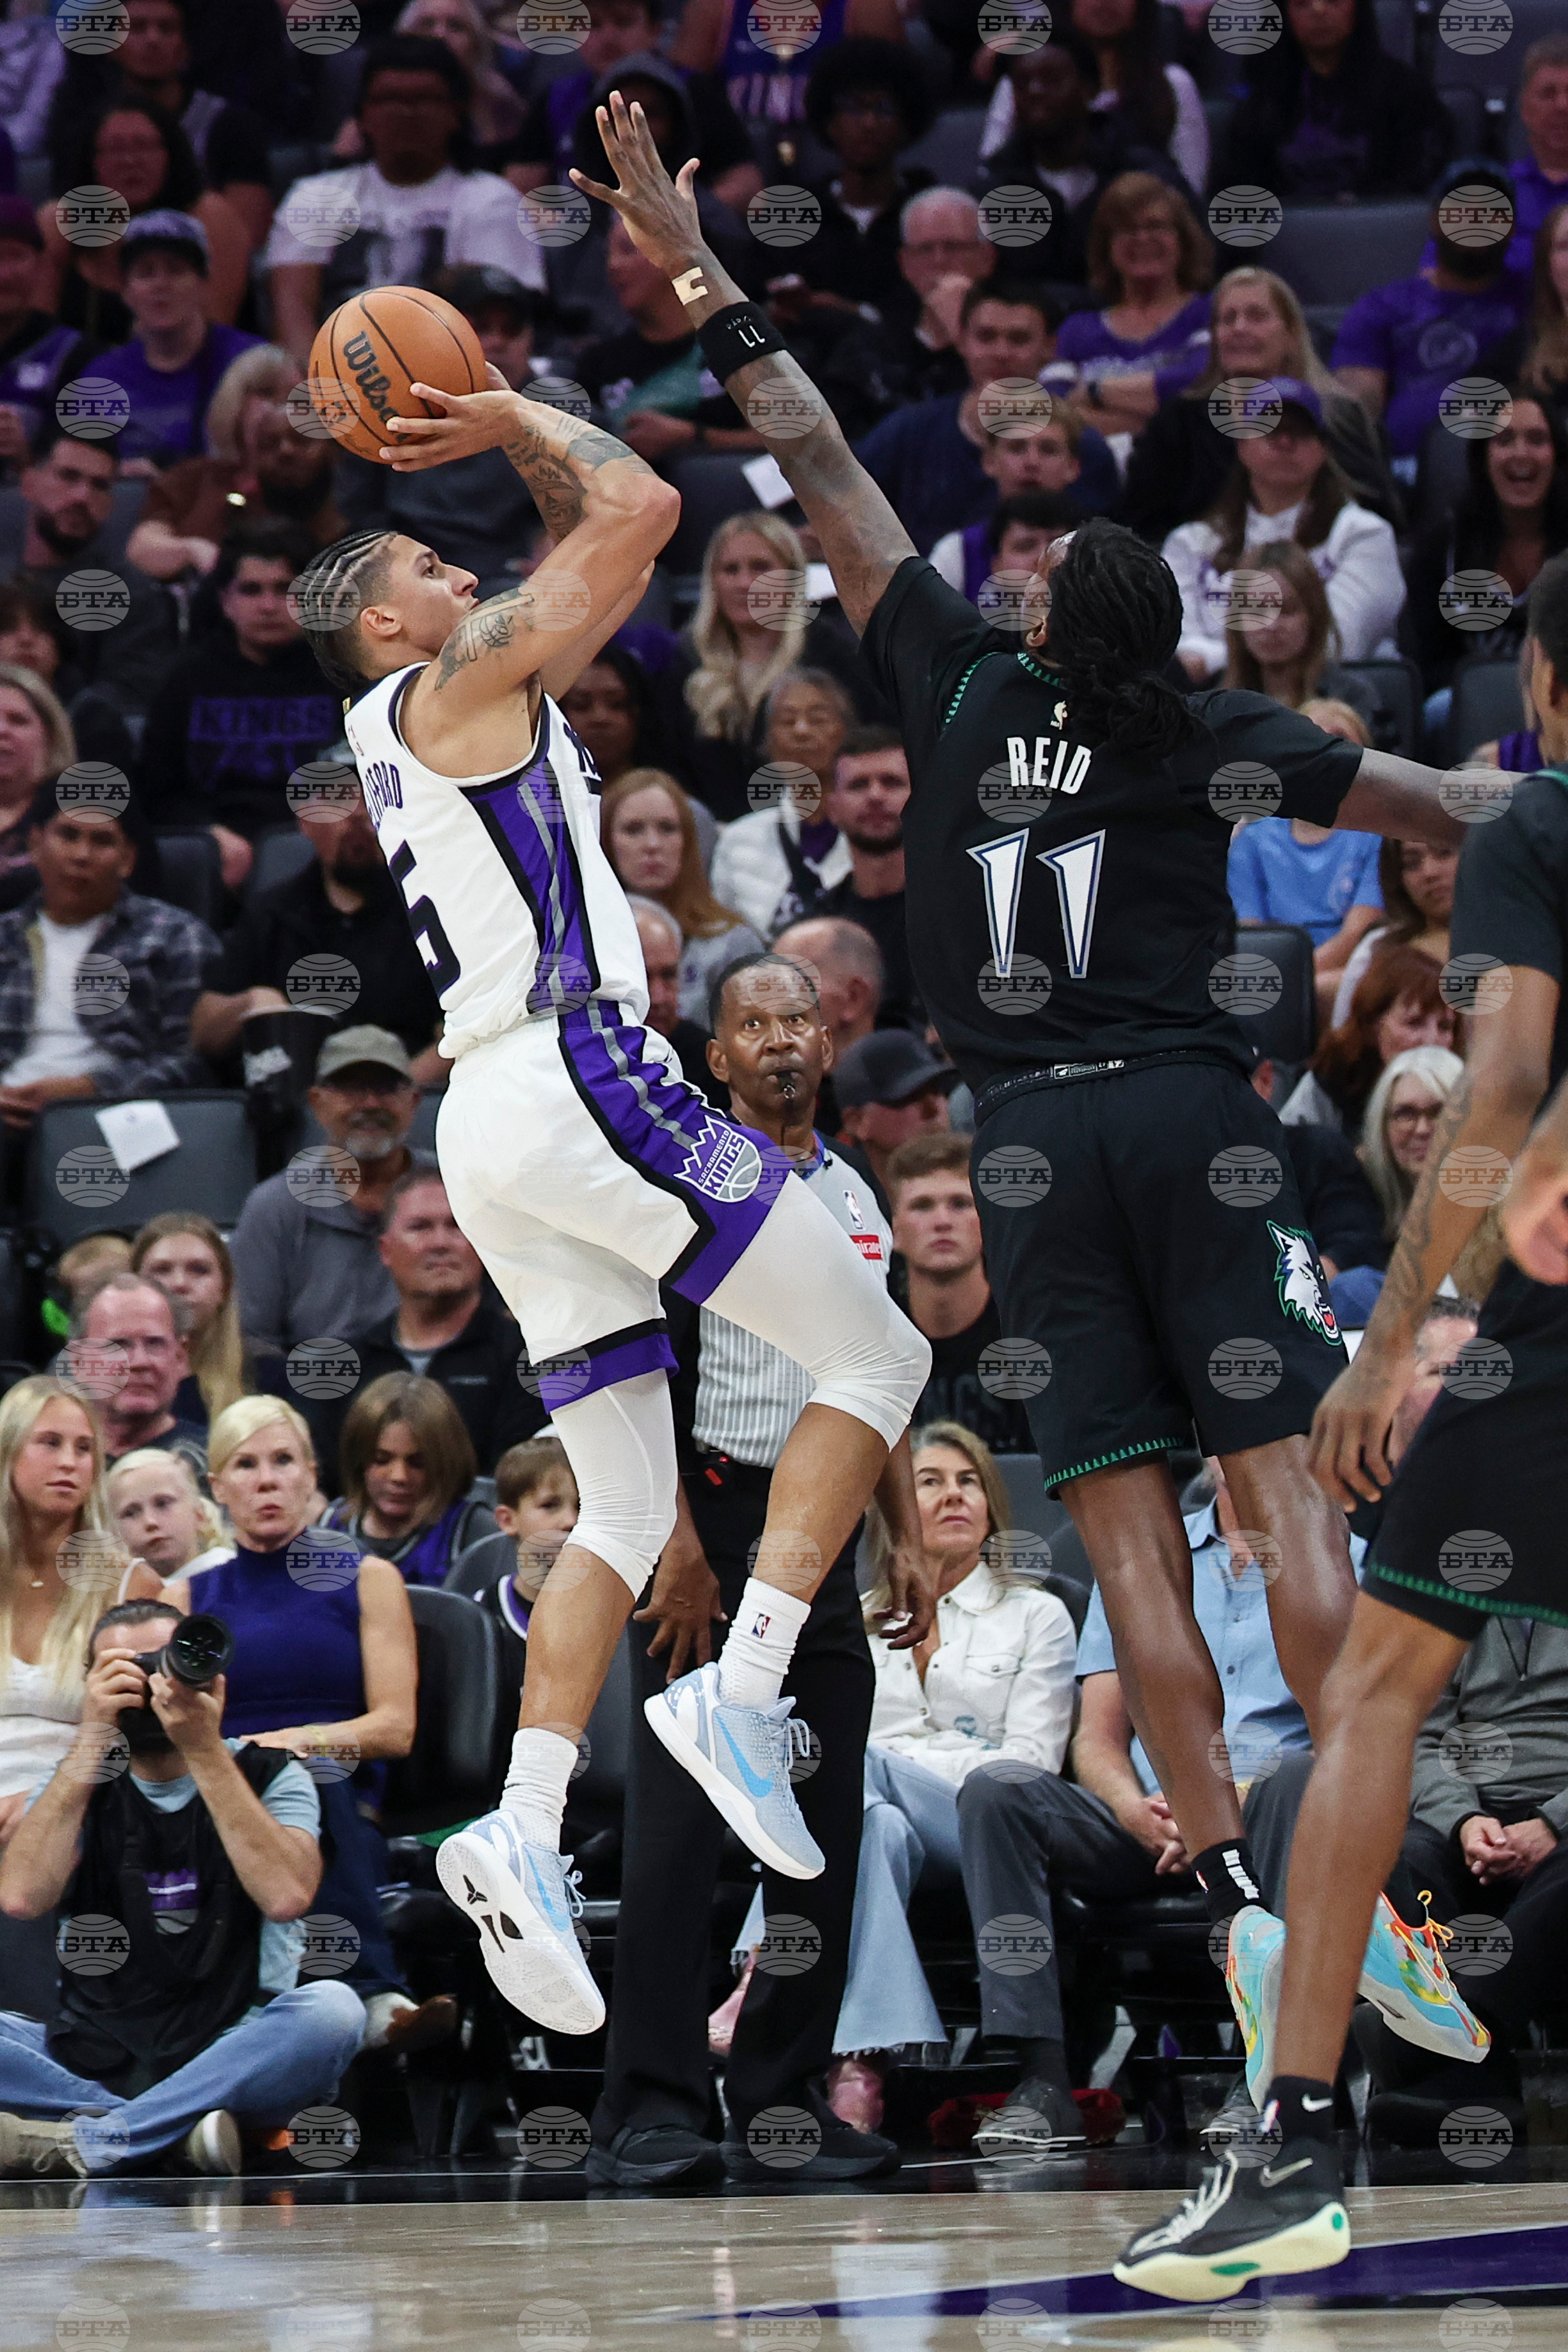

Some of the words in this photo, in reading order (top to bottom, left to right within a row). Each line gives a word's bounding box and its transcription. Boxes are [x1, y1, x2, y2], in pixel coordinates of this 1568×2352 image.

[343, 330, 412, 442] Wilso
[1006, 737, 1092, 795] REID
[388, 839, 461, 1000] 5
[966, 827, 1106, 980] 11
[698, 1130, 730, 1185] SACRAMENTO
[704, 1134, 746, 1196] KINGS
